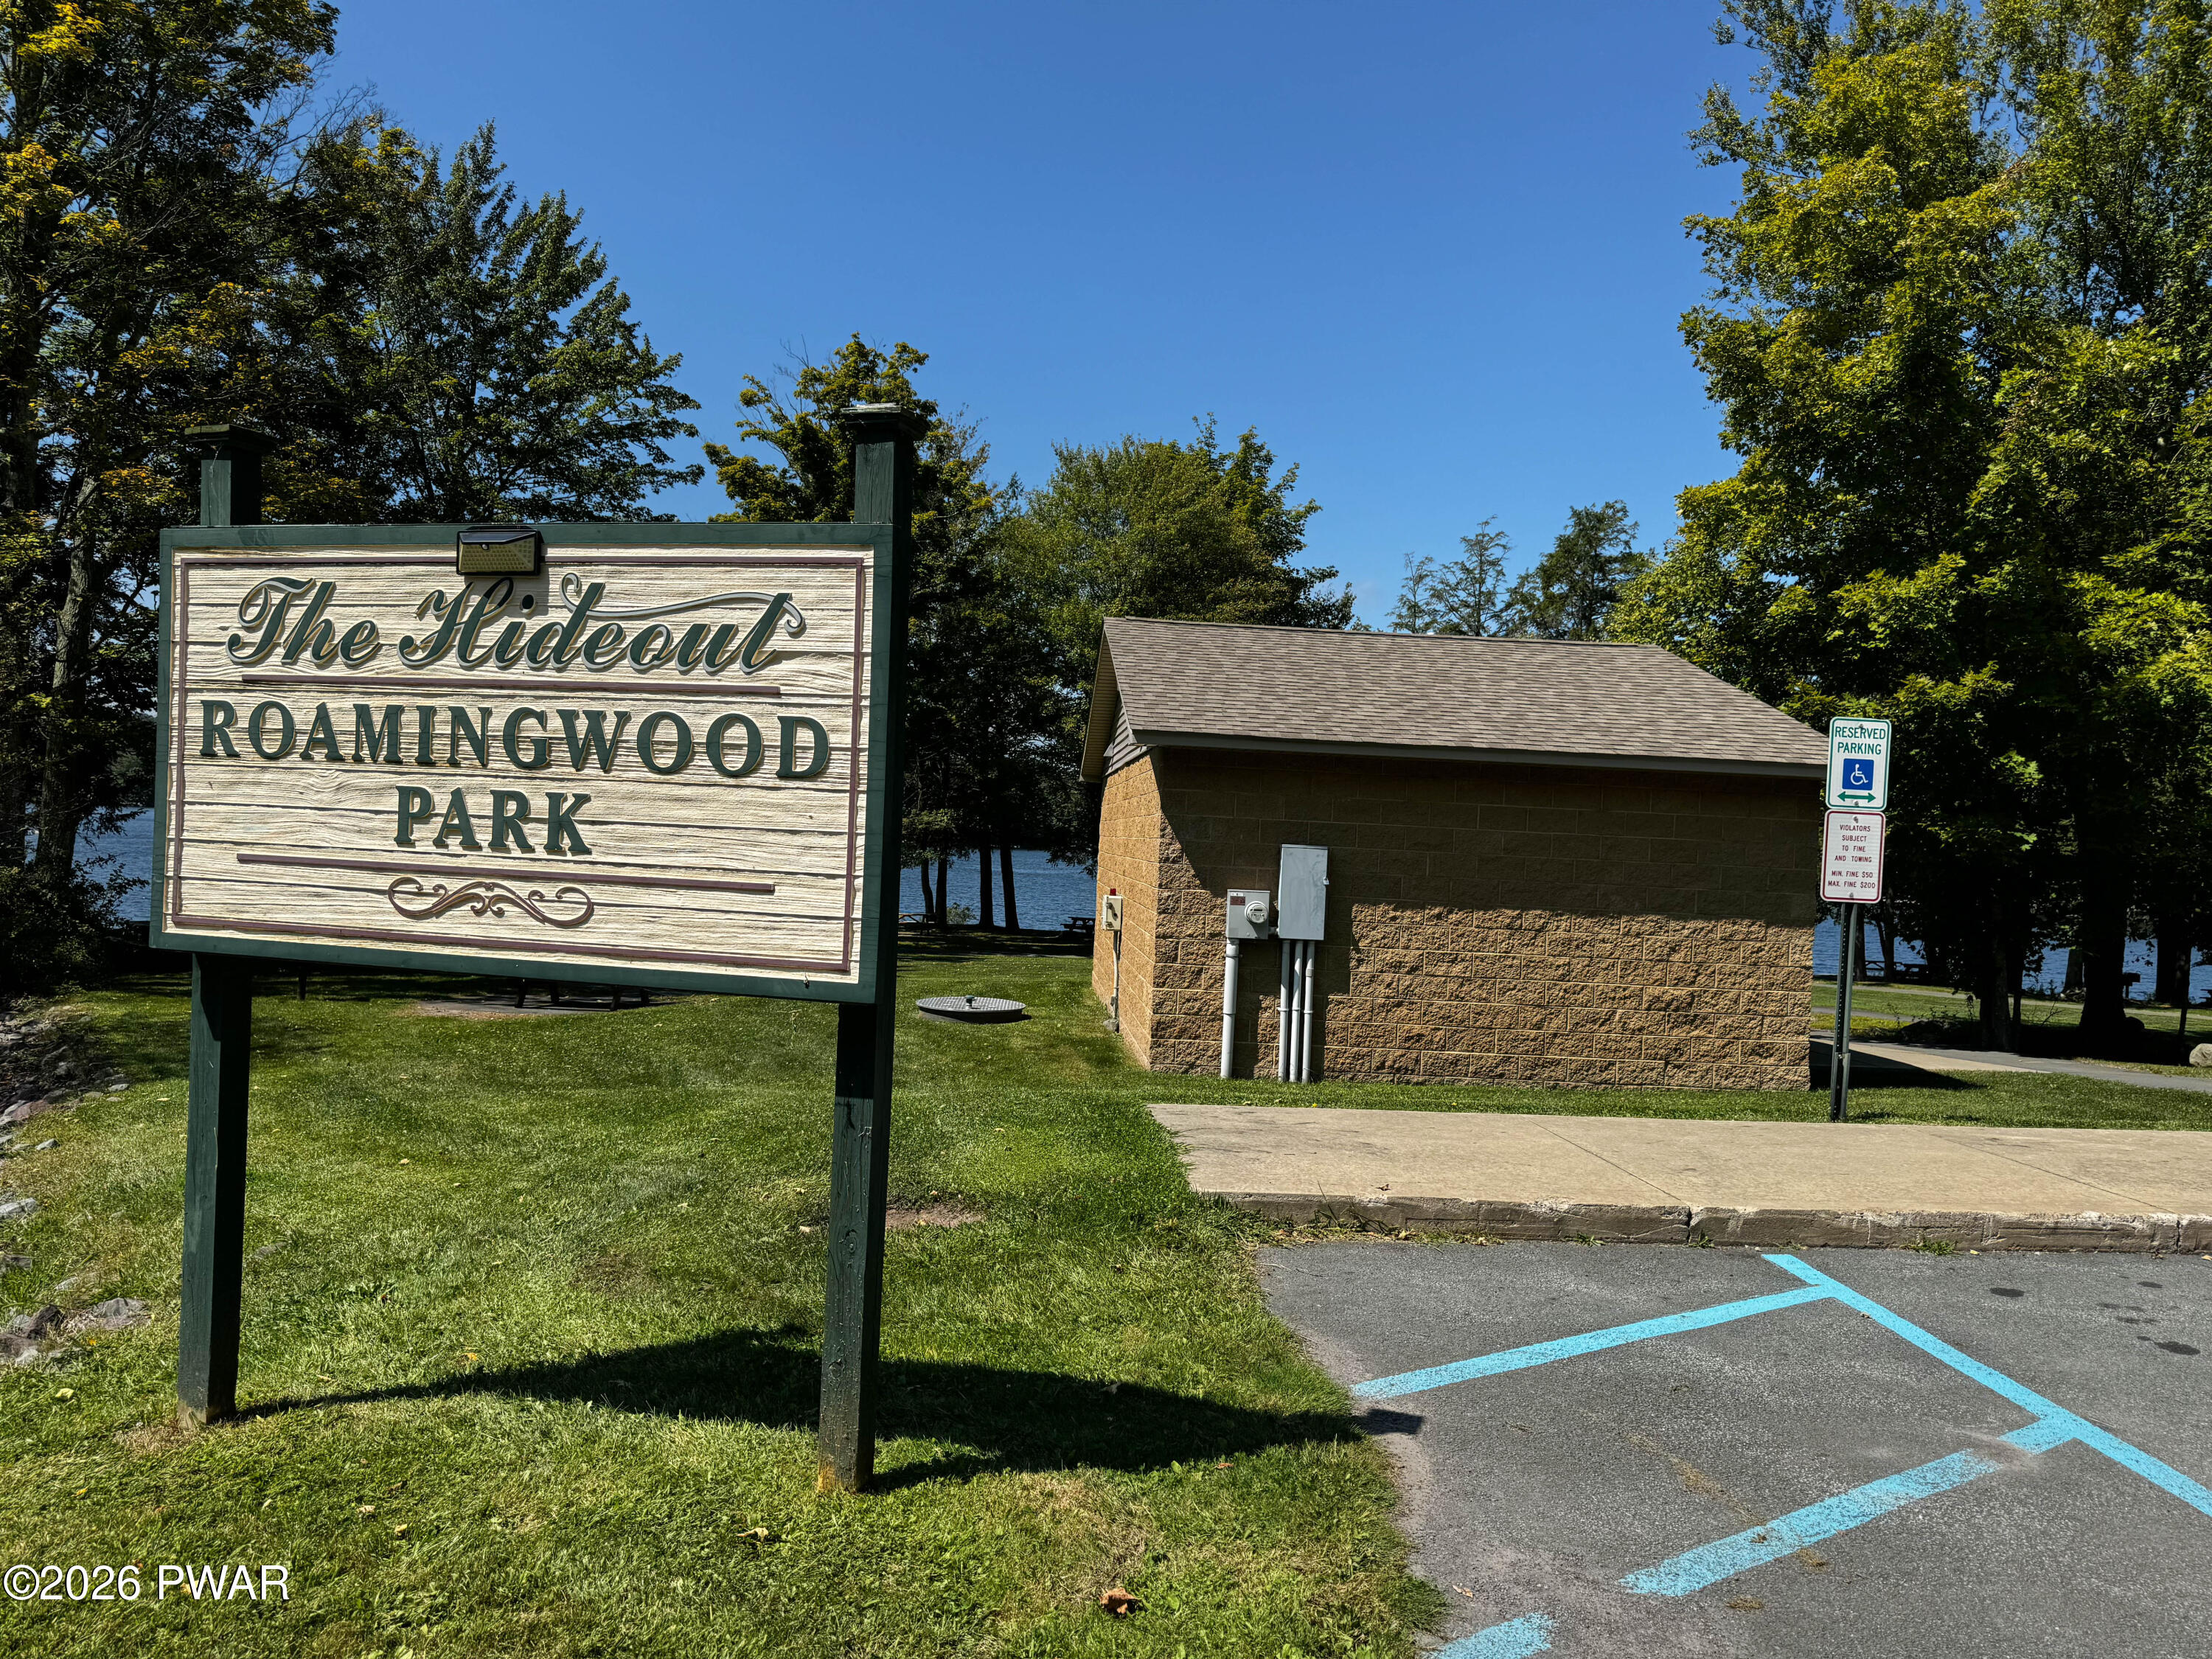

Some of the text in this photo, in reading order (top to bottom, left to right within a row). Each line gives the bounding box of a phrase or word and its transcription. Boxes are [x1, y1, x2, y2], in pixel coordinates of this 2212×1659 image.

[226, 572, 805, 675] The Hideout
[200, 699, 831, 779] ROAMINGWOOD
[1834, 726, 1886, 740] RESERVED
[1837, 742, 1882, 755] PARKING
[394, 785, 593, 855] PARK
